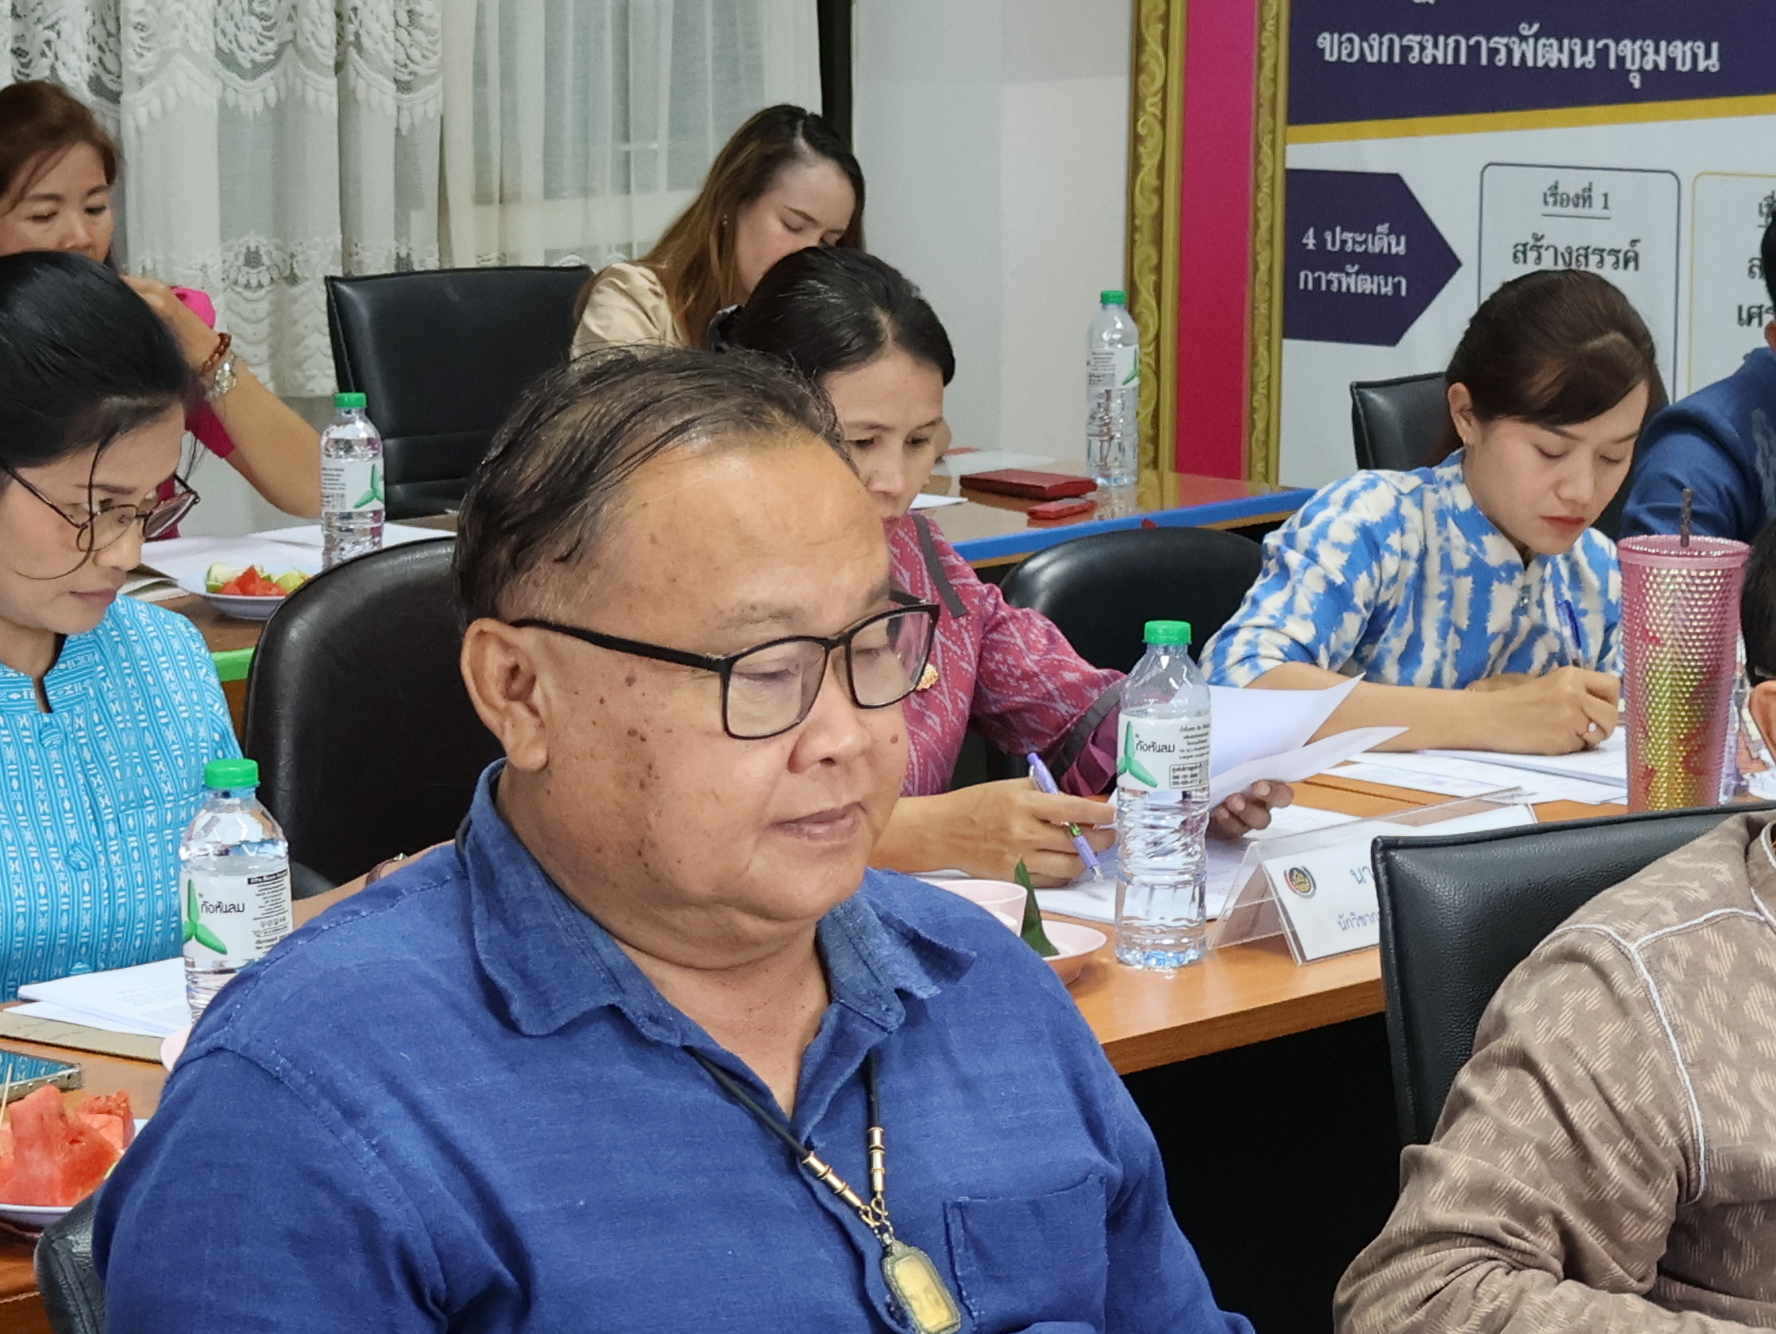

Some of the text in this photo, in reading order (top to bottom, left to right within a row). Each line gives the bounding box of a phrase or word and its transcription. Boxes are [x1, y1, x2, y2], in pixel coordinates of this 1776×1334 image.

[1315, 22, 1721, 91] ของกรมการพัฒนาชุมชน
[1541, 181, 1611, 213] เรื่องที่ 1
[1300, 223, 1407, 258] 4 ประเด็น
[1512, 231, 1641, 273] สร้างสรรค์
[1297, 264, 1408, 298] การพัฒนา
[1336, 911, 1379, 932] นักวิชาก
